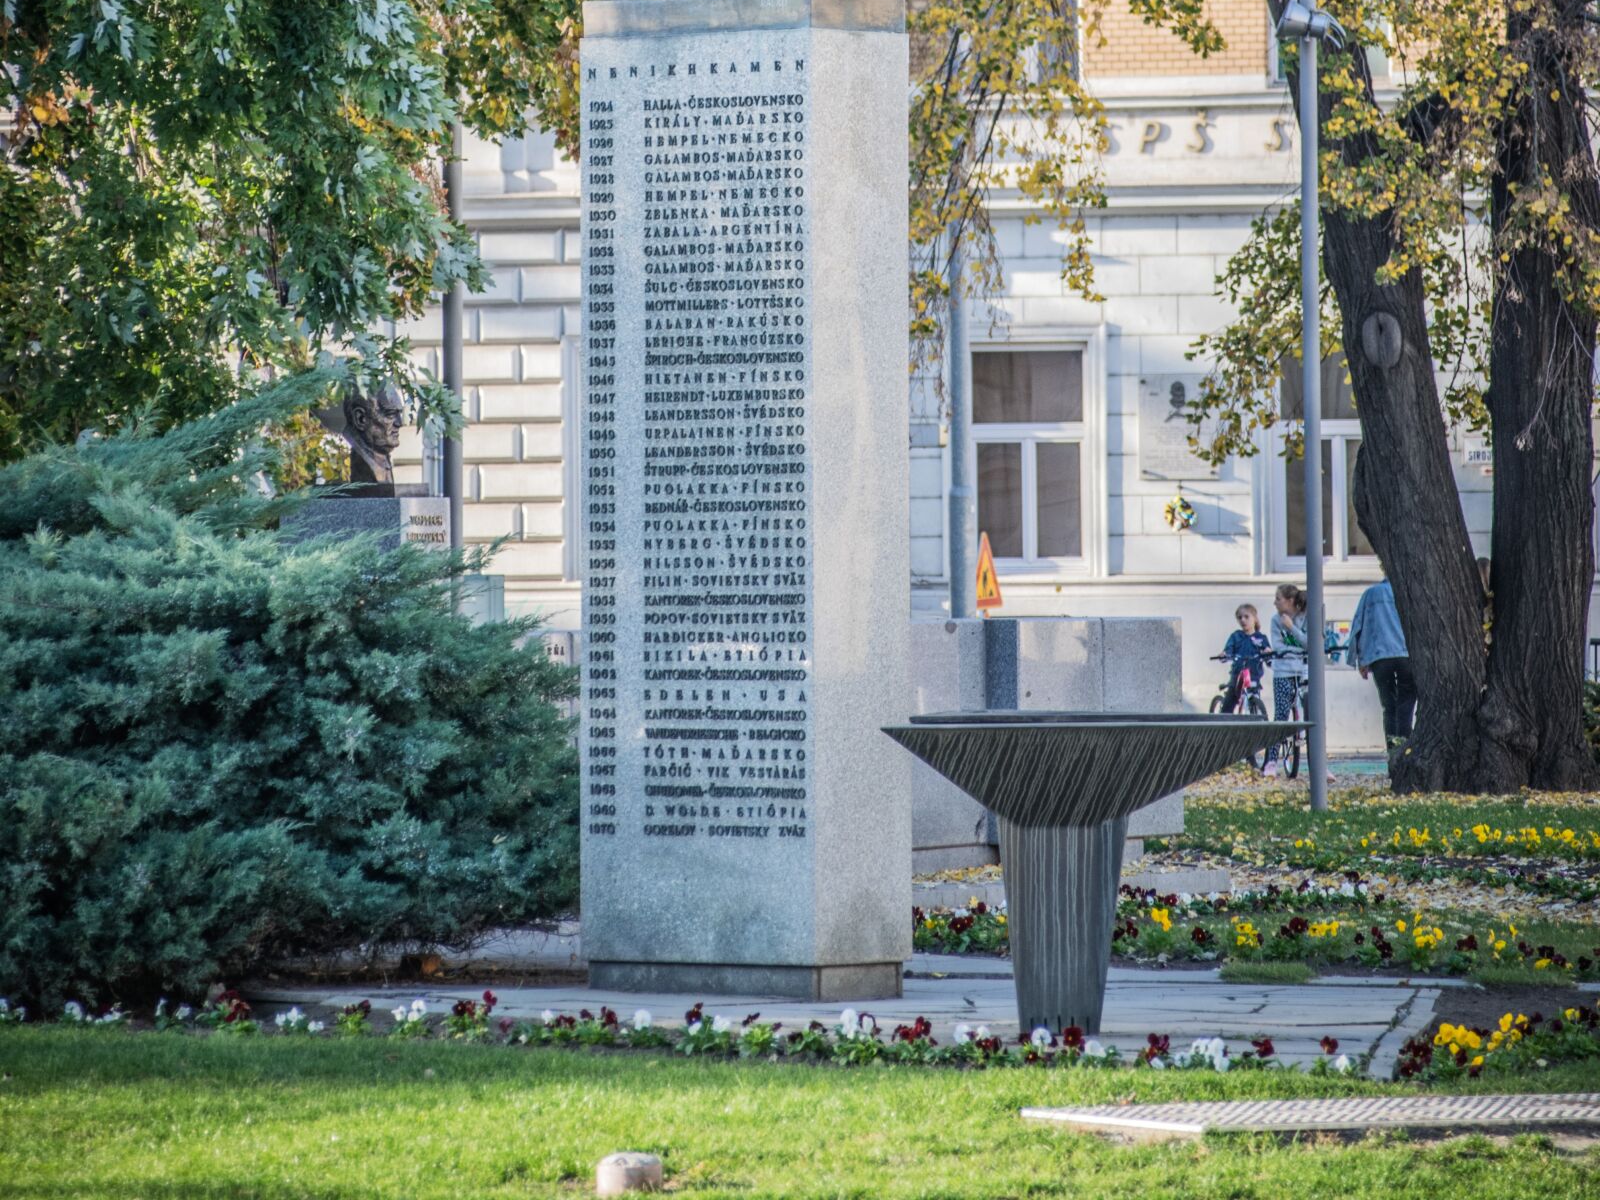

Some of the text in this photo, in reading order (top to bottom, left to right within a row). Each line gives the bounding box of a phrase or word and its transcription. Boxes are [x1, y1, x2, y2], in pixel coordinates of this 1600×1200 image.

[590, 101, 613, 112] 1924
[589, 119, 614, 130] 1925
[589, 138, 613, 148] 1926
[590, 155, 613, 166] 1927
[590, 173, 614, 184] 1928
[589, 192, 614, 204] 1929
[589, 210, 616, 221] 1930
[589, 228, 614, 239] 1931
[589, 246, 614, 258] 1932
[589, 265, 615, 276] 1933
[588, 283, 613, 295] 1934
[589, 302, 614, 313] 1935
[589, 319, 616, 331] 1936
[589, 337, 615, 349] 1937
[589, 356, 615, 367] 1945
[589, 375, 614, 386] 1946
[589, 393, 615, 404] 1947
[589, 411, 615, 422] 1948
[589, 429, 616, 441] 1949
[589, 447, 615, 459] 1950
[589, 466, 614, 478] 1951
[589, 484, 615, 496] 1952
[589, 503, 615, 514] 1953
[590, 521, 615, 533] 1954
[590, 540, 615, 550] 1955
[590, 558, 615, 569] 1956
[589, 577, 615, 588] 1957
[588, 595, 615, 606] 1958
[589, 614, 616, 625] 1959
[590, 632, 616, 643] 1960
[590, 650, 614, 662] 1961
[590, 668, 616, 680] 1962
[589, 688, 615, 699] 1963
[590, 708, 616, 719] 1964
[590, 727, 615, 738] 1965
[589, 746, 616, 757] 1966
[590, 765, 616, 776] 1967
[590, 784, 615, 795] 1968
[590, 804, 616, 816] 1969
[590, 823, 615, 835] 1970
